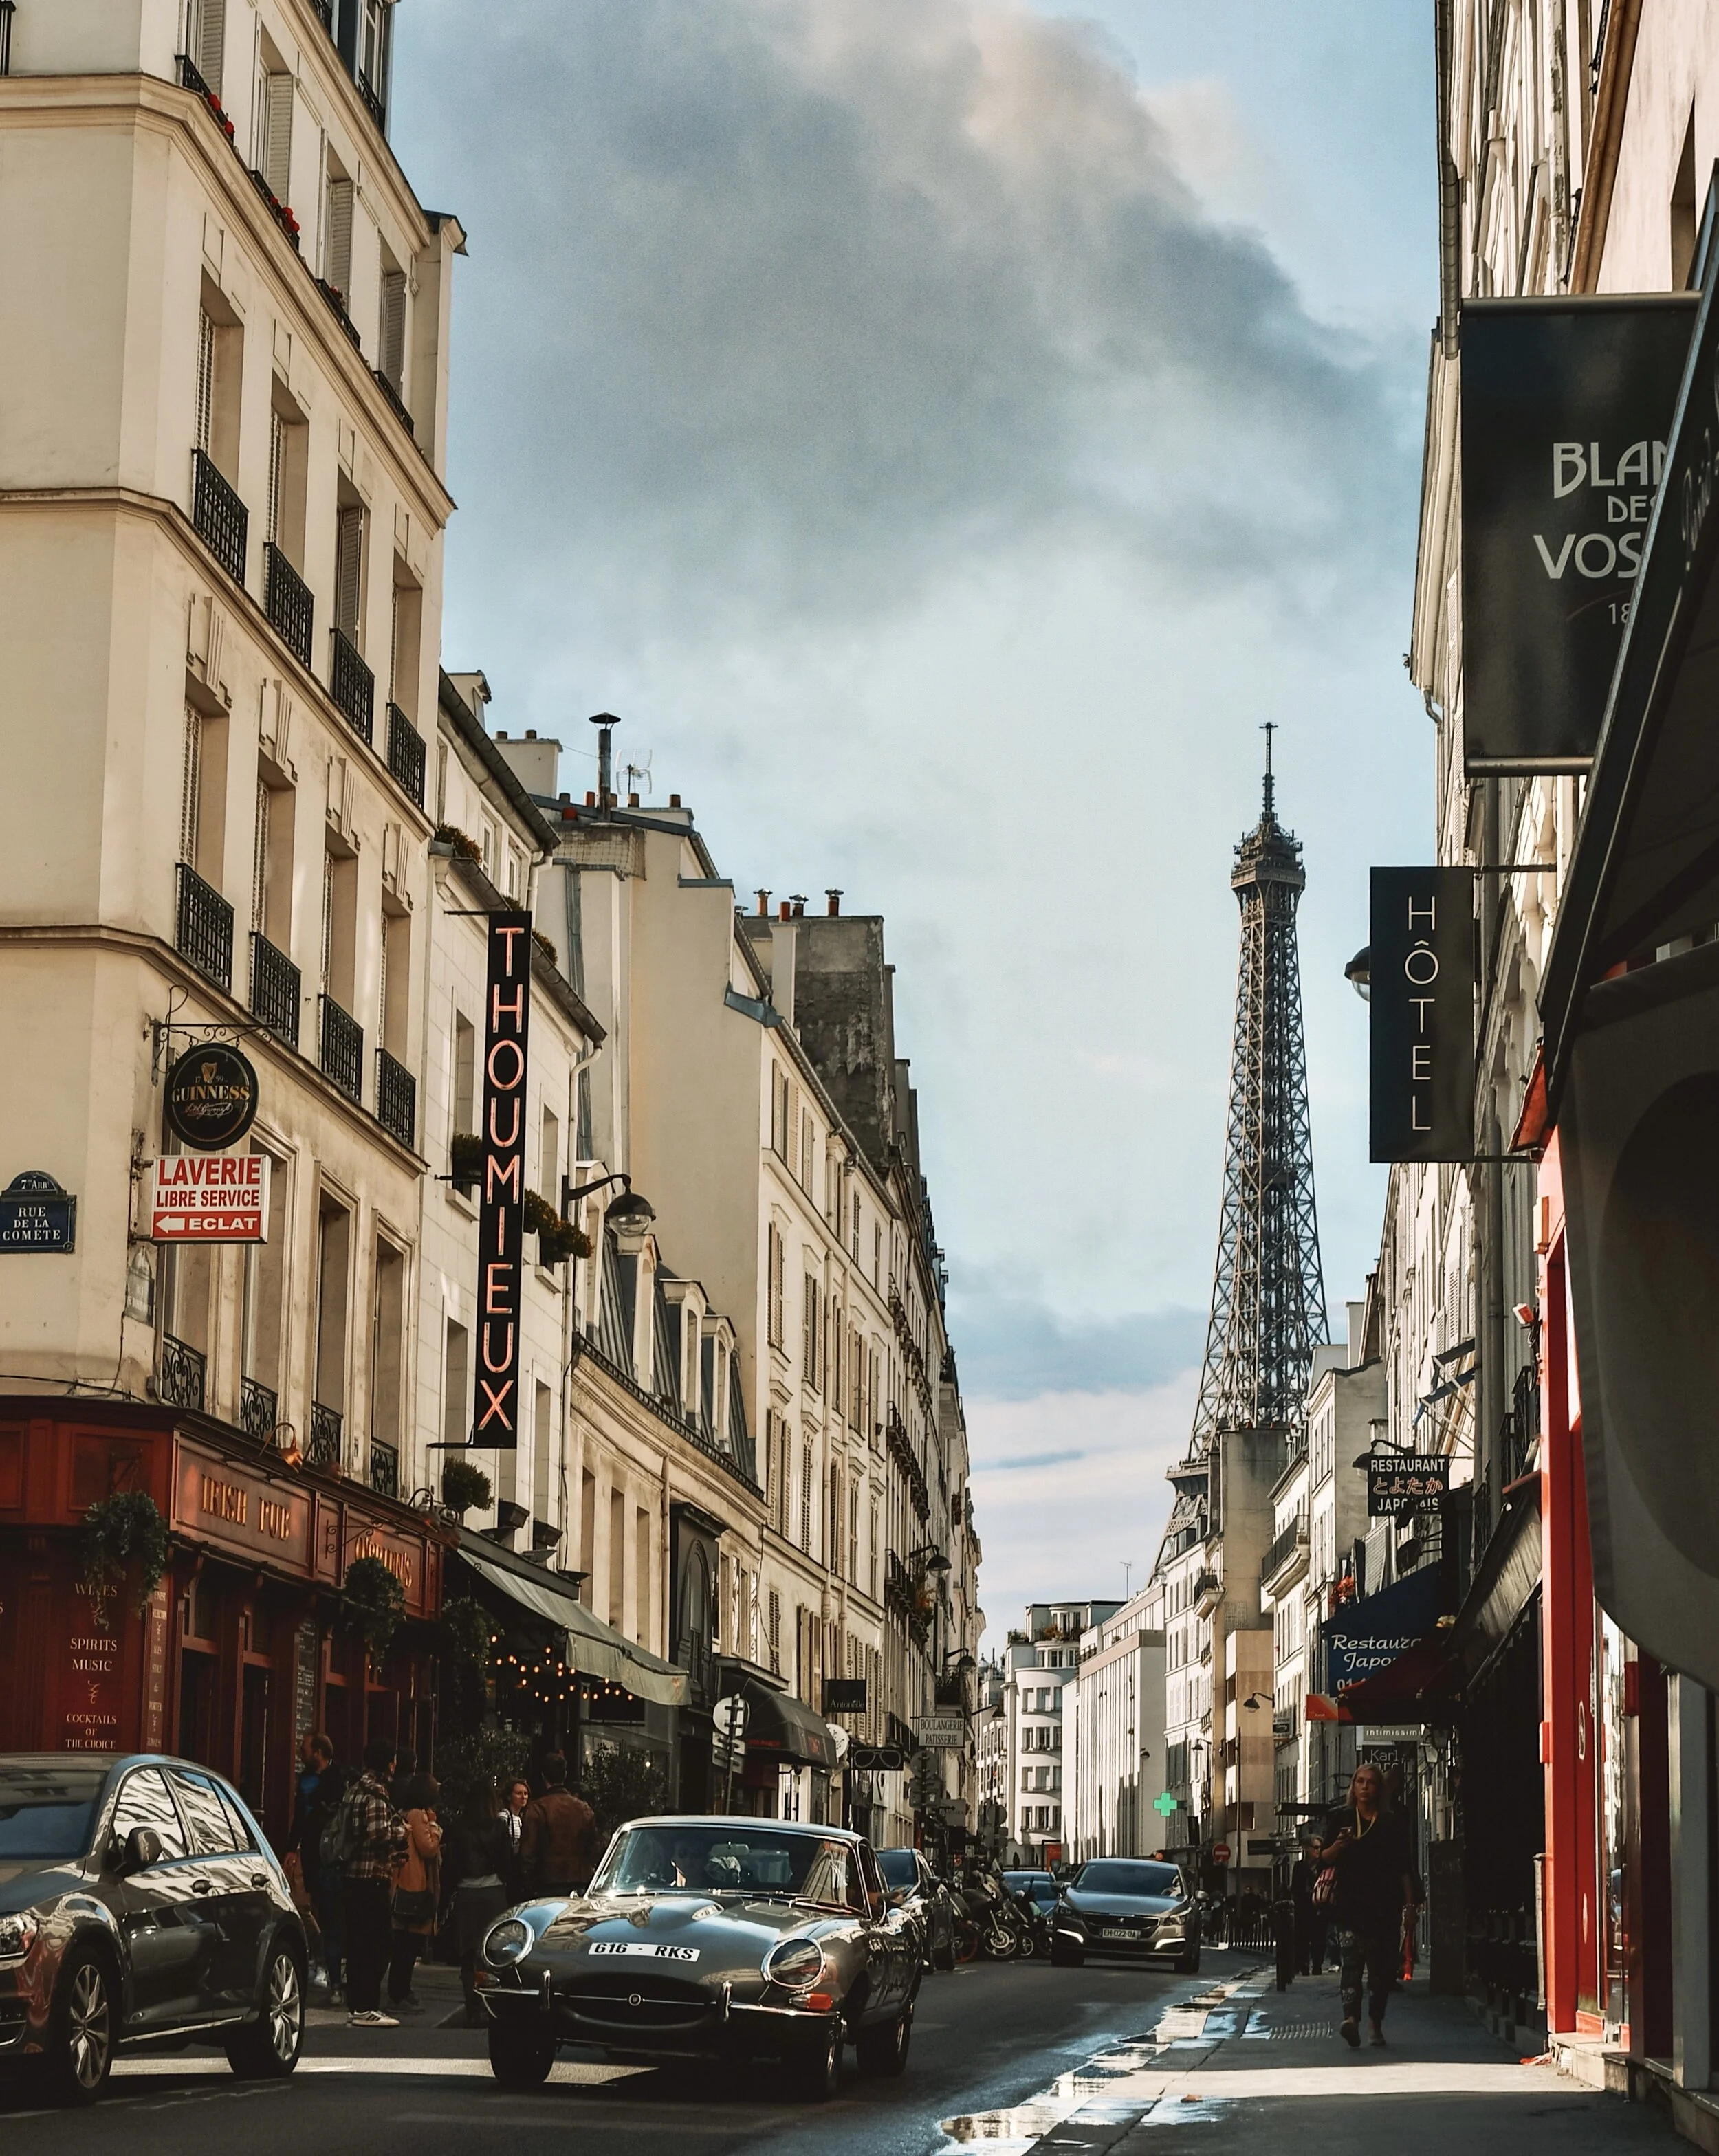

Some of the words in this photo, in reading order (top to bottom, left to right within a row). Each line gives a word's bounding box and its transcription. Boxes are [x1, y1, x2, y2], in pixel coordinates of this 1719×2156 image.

[1608, 495, 1656, 523] DE
[1404, 896, 1439, 1131] HÔTEL
[172, 1085, 250, 1103] GUINNESS
[159, 1158, 261, 1185] LAVERIE
[477, 927, 525, 1431] THOUMIEUX
[156, 1190, 197, 1208] LIBRE
[200, 1189, 260, 1207] SERVICE
[19, 1207, 46, 1218] RUE
[14, 1219, 29, 1229] DE
[34, 1219, 50, 1228] LA
[188, 1218, 258, 1231] ECLAT
[1370, 1458, 1445, 1472] RESTAURANT
[1373, 1476, 1443, 1495] とよたか
[201, 1475, 247, 1526] IRISH
[259, 1497, 290, 1541] PUB
[1377, 1497, 1439, 1511] JAPAIS
[75, 1583, 118, 1597] WIES
[70, 1638, 118, 1651] SPIRITS
[72, 1658, 113, 1671] MUSIC
[1343, 1651, 1396, 1672] Japo
[66, 1713, 116, 1724] COCKTAILS
[921, 1719, 963, 1730] BOULANGERIE
[65, 1739, 83, 1748] THE
[85, 1739, 116, 1749] CHOICE
[925, 1734, 958, 1745] PATISSERIE
[1370, 1749, 1399, 1762] Karl
[594, 1943, 628, 1954] 616
[655, 1946, 694, 1959] RKS
